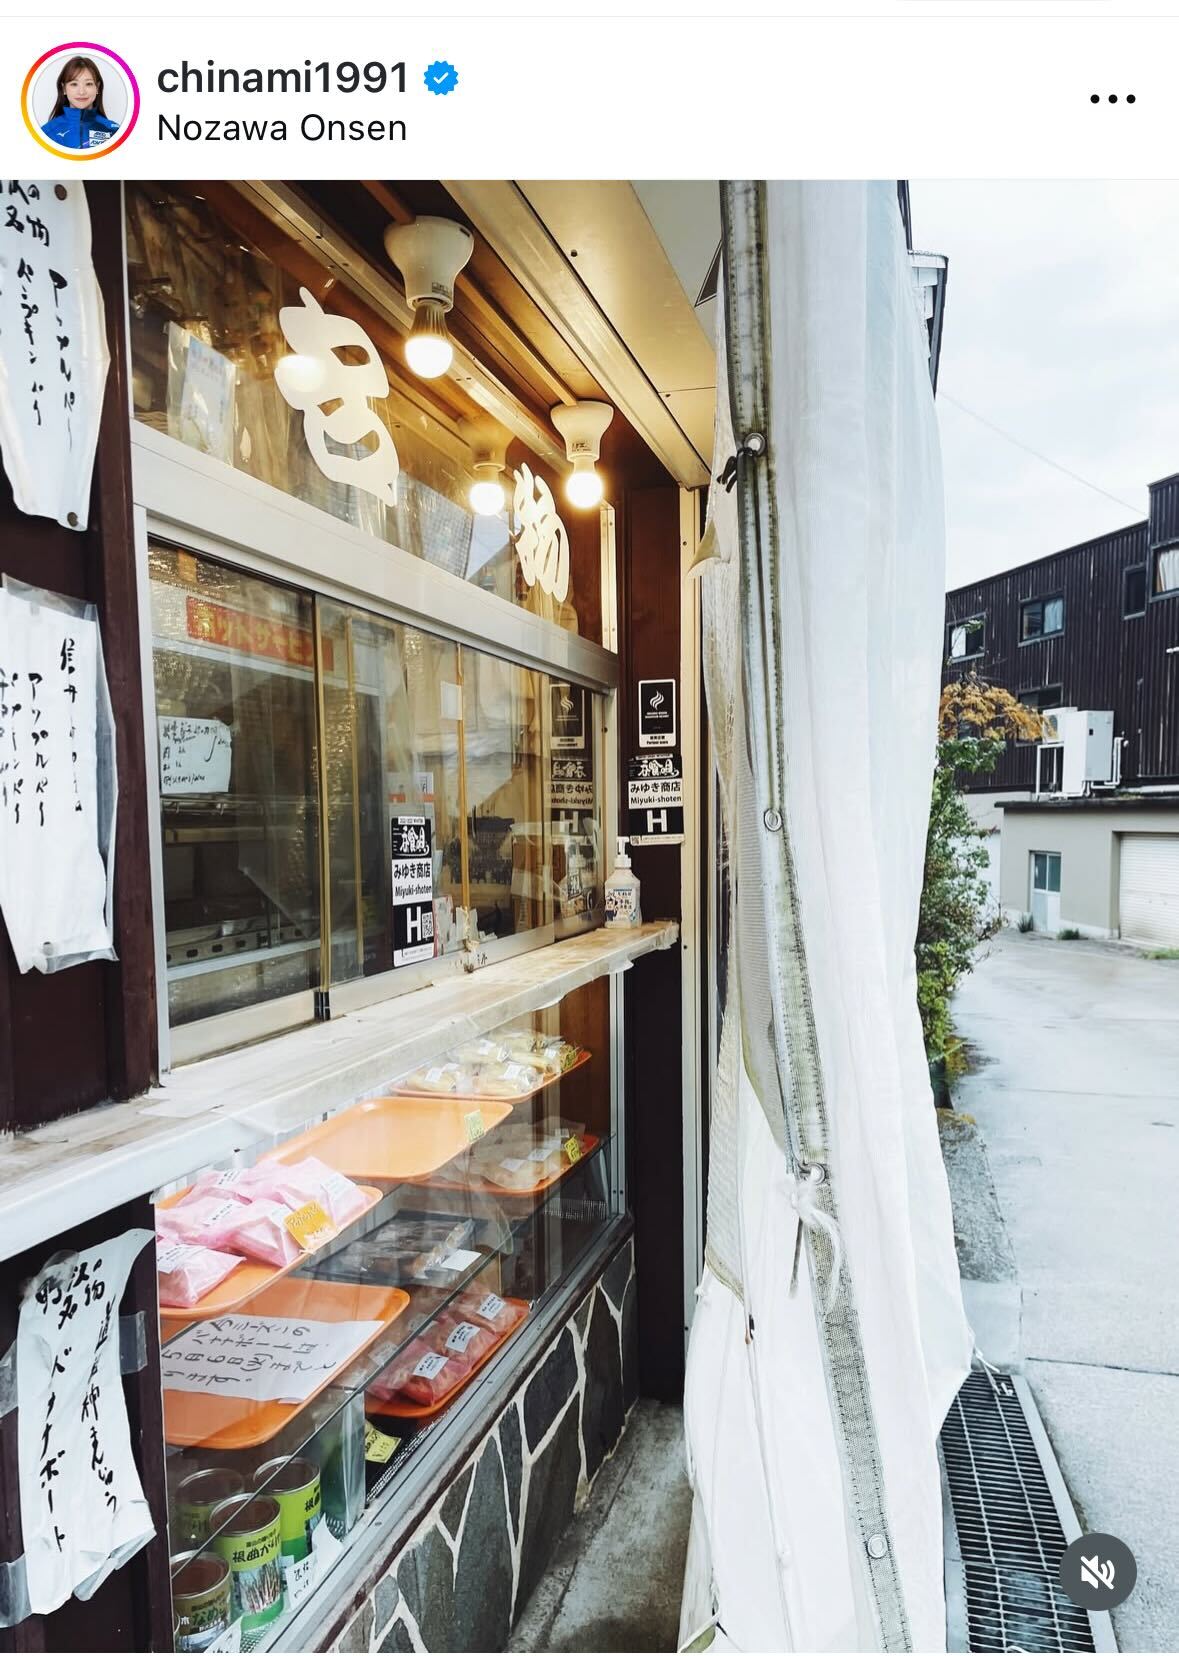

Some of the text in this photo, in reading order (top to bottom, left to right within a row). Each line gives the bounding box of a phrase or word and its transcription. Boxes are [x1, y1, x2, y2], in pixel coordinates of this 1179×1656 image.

[630, 782, 681, 793] みゆき商店
[630, 796, 681, 805] Miyuki-shoten
[647, 810, 667, 832] H
[394, 862, 431, 879] みゆき商店
[395, 885, 432, 899] Miyuki-shoten
[407, 906, 422, 943] H
